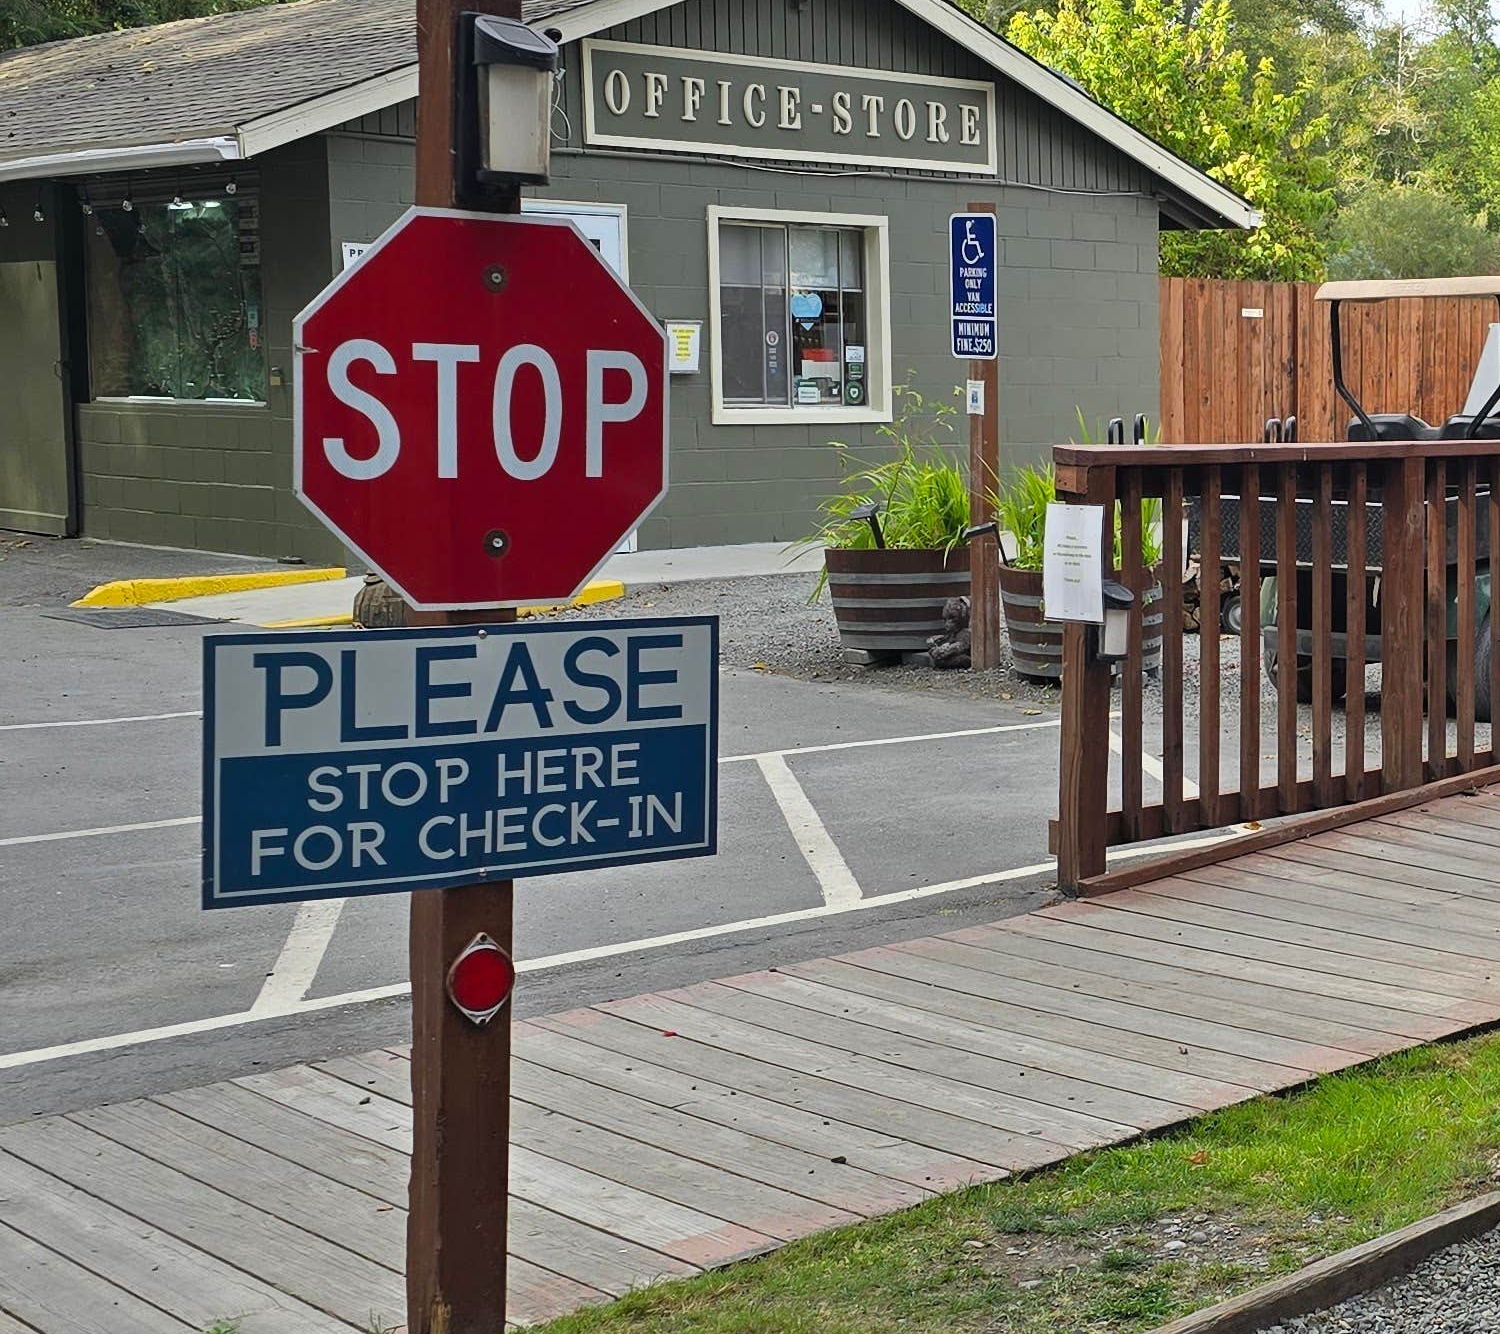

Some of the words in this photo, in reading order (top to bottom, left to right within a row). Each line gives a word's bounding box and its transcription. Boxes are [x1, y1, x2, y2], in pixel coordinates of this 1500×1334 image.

[960, 267, 987, 278] PARKING
[965, 279, 981, 289] ONLY
[967, 292, 980, 302] VAN
[955, 303, 992, 313] ACCESSIBLE
[959, 323, 989, 336] MINIMUM
[957, 338, 972, 351] FINE
[974, 339, 992, 353] $250
[322, 338, 648, 480] STOP
[252, 633, 685, 748] PLEASE
[307, 757, 471, 813] STOP
[496, 742, 641, 797] HERE
[250, 823, 387, 877] FOR
[418, 790, 684, 860] CHECK-IN
